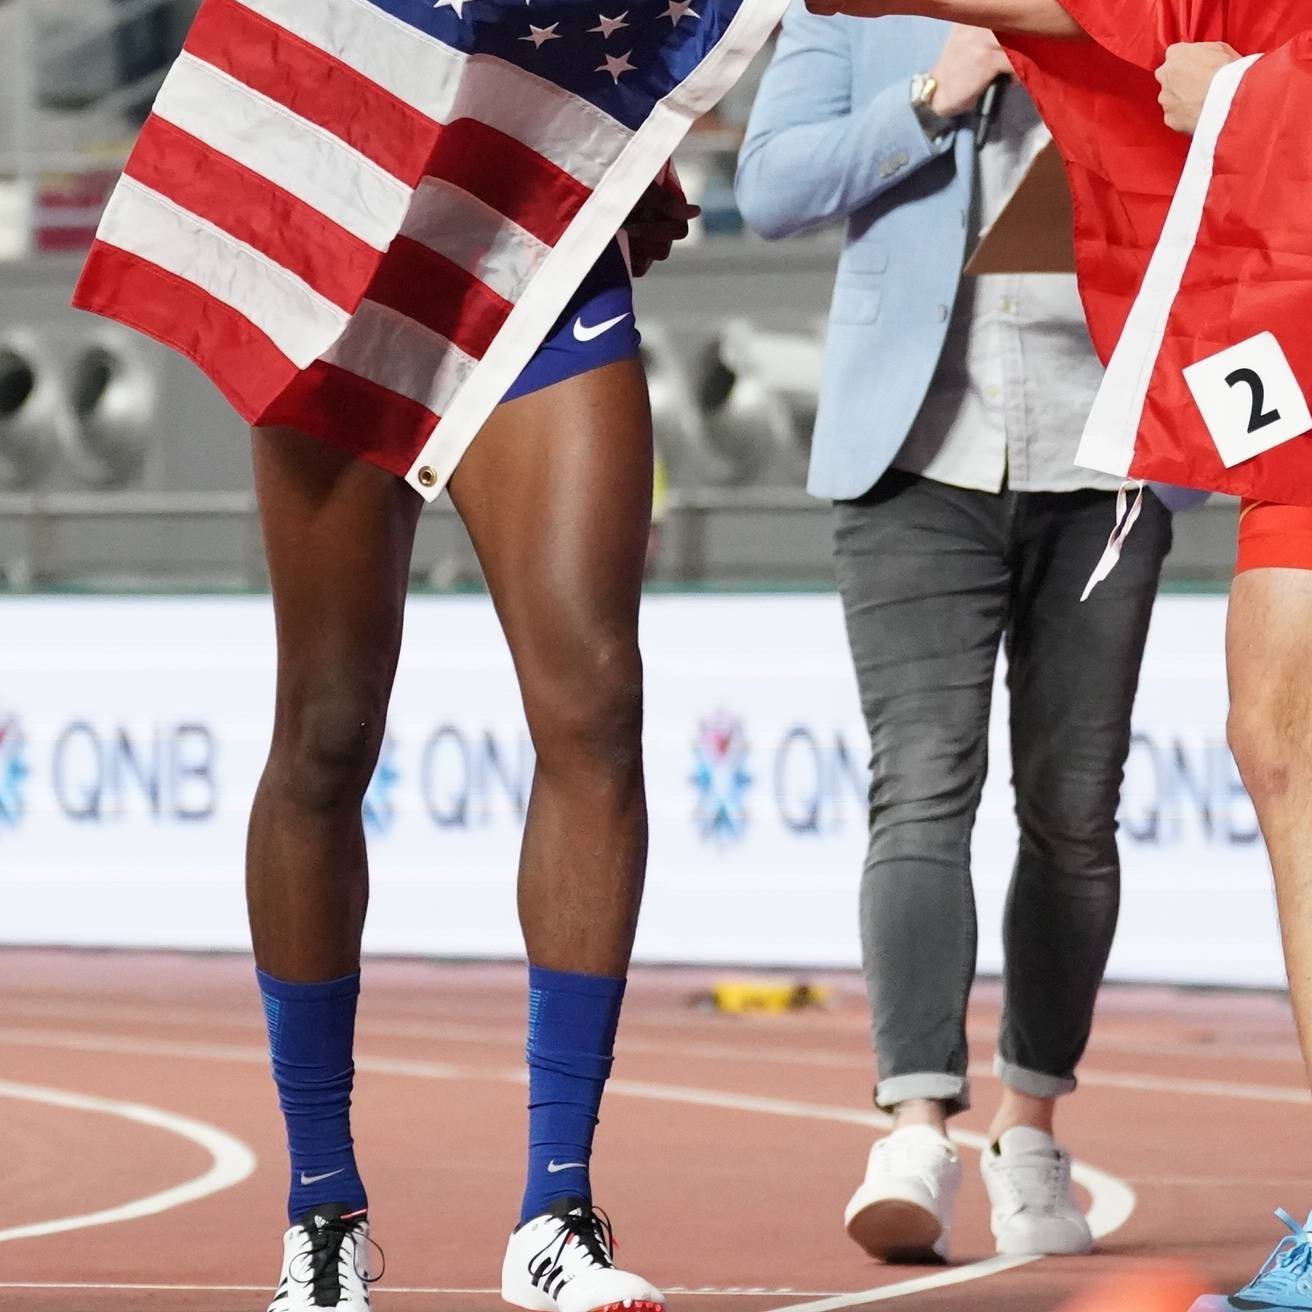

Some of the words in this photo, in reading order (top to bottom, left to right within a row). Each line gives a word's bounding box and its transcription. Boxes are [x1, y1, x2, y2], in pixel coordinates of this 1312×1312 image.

[1224, 368, 1281, 434] 2
[50, 719, 217, 822] QNB
[420, 722, 533, 831] QN
[773, 724, 872, 835] QN
